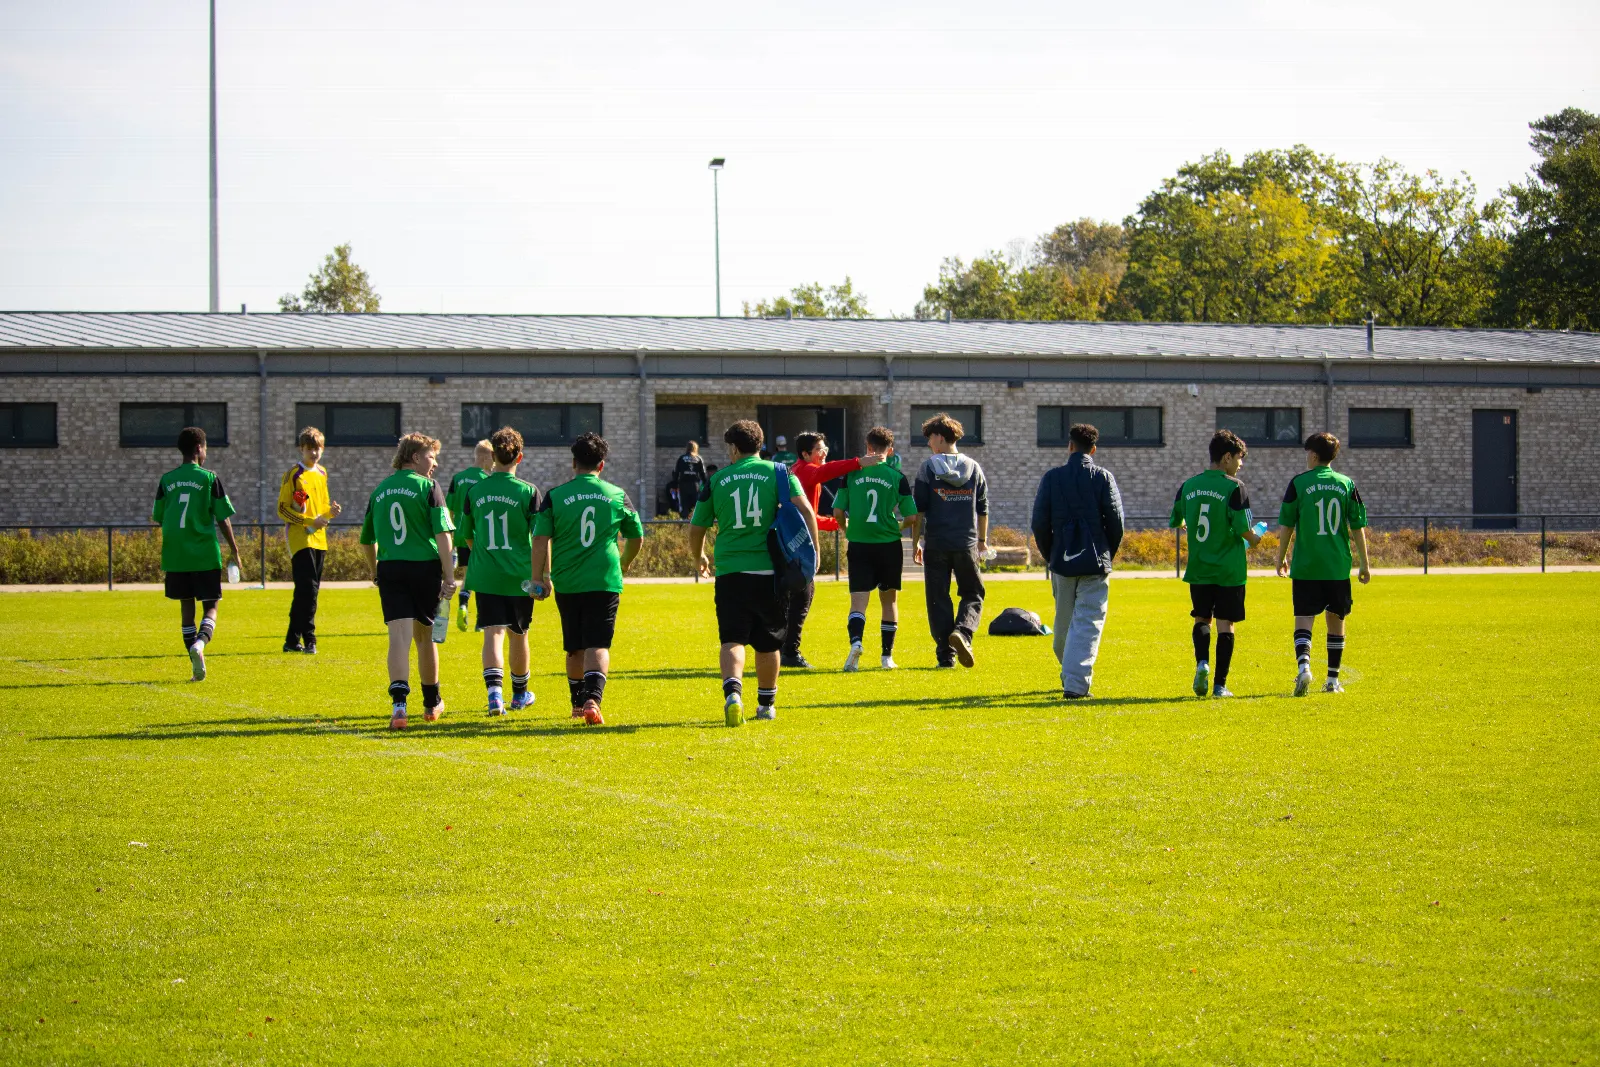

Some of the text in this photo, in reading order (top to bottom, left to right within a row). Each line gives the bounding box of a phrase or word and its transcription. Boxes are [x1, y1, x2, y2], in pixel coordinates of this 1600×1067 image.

[375, 487, 418, 502] GW Brockdorf
[720, 472, 769, 487] GW Brockdorf
[1196, 489, 1226, 502] Brockdorf
[178, 493, 190, 528] 7
[475, 495, 519, 508] GW Brockdorf
[563, 493, 612, 506] GW Brockdorf
[730, 481, 763, 529] 14
[866, 489, 878, 523] 2
[1315, 497, 1341, 536] 10
[390, 501, 407, 545] 9
[484, 509, 512, 550] 11
[580, 505, 596, 548] 6
[1196, 503, 1210, 543] 5
